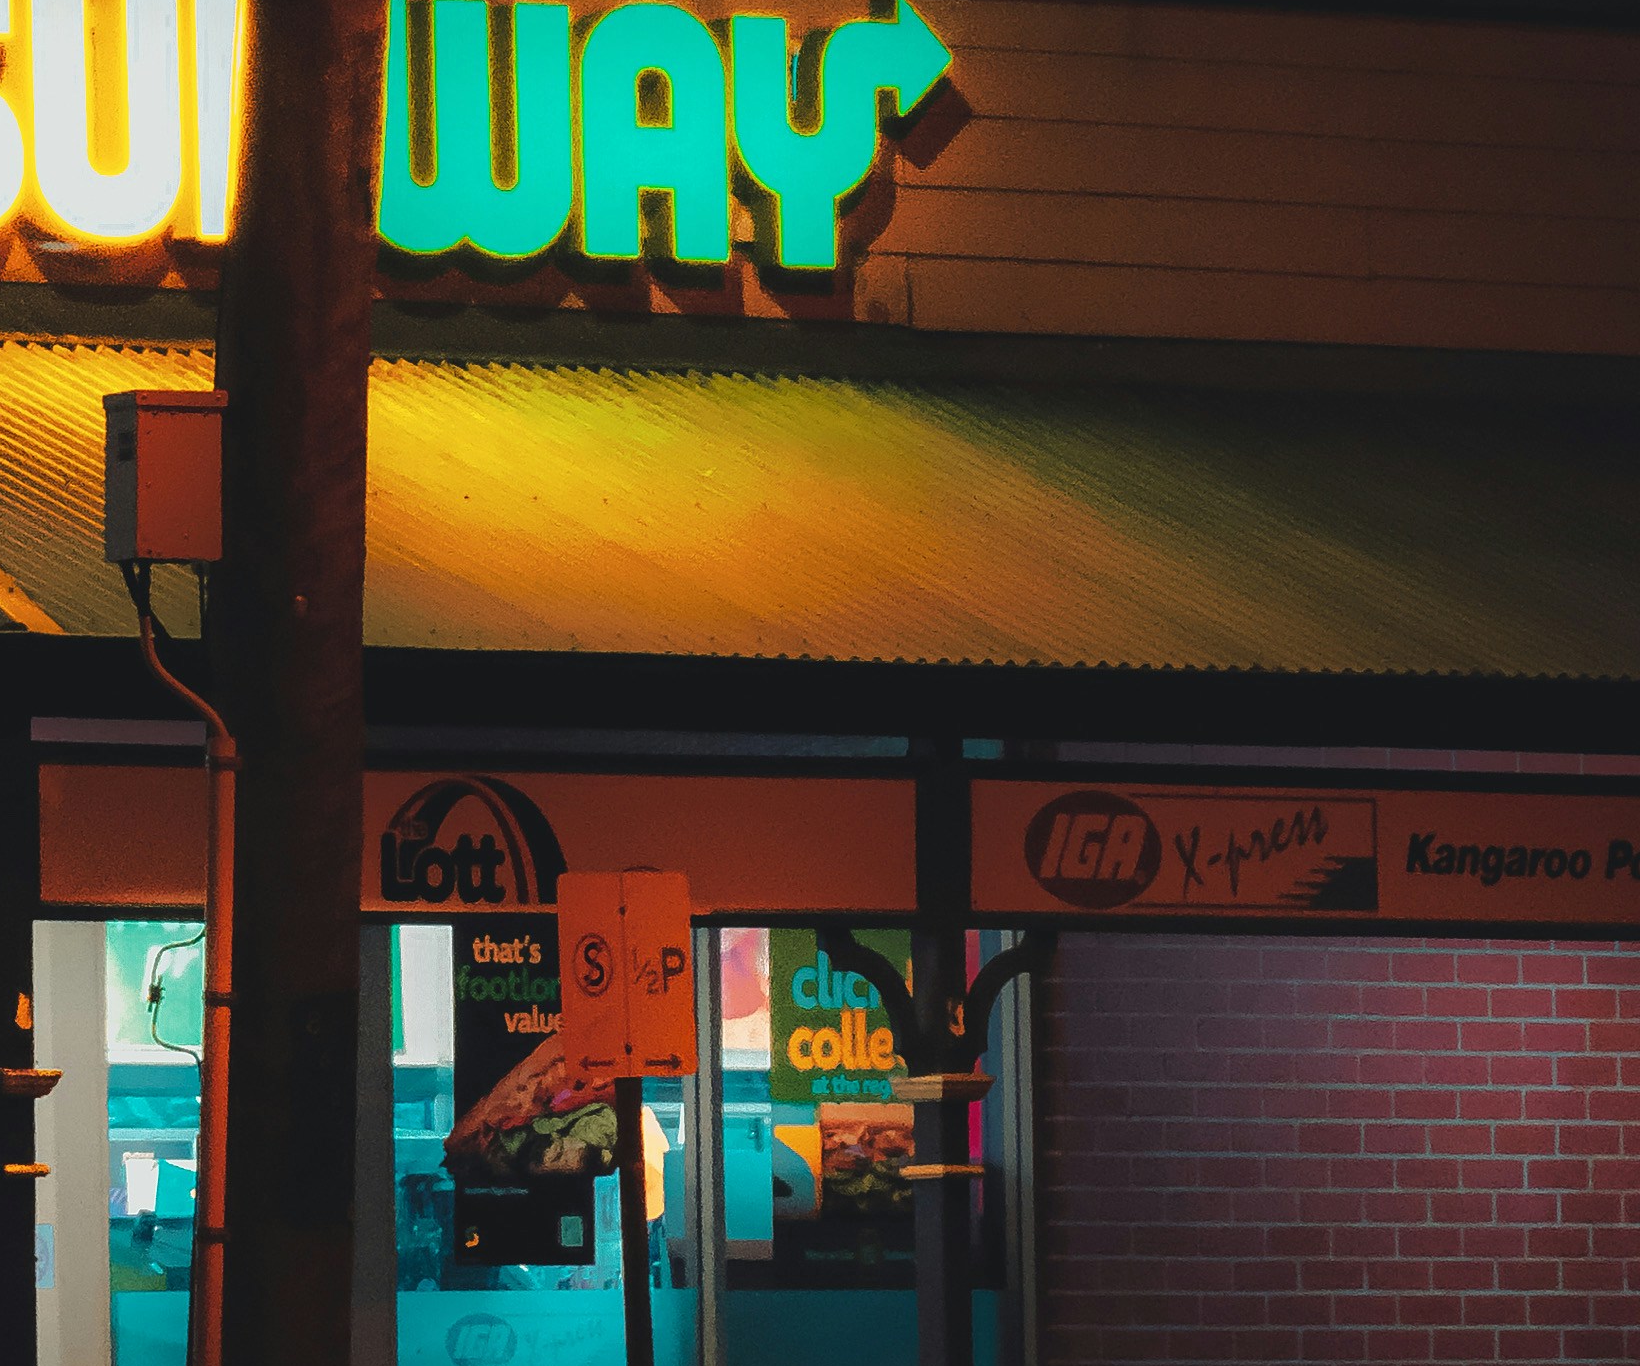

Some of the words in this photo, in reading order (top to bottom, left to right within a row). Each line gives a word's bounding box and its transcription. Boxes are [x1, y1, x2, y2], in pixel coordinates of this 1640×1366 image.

[1040, 812, 1148, 881] IGA
[1174, 805, 1330, 900] X-press
[1405, 832, 1592, 887] Kangaroo
[471, 934, 543, 965] that's
[582, 941, 606, 987] S
[786, 1006, 906, 1071] colle
